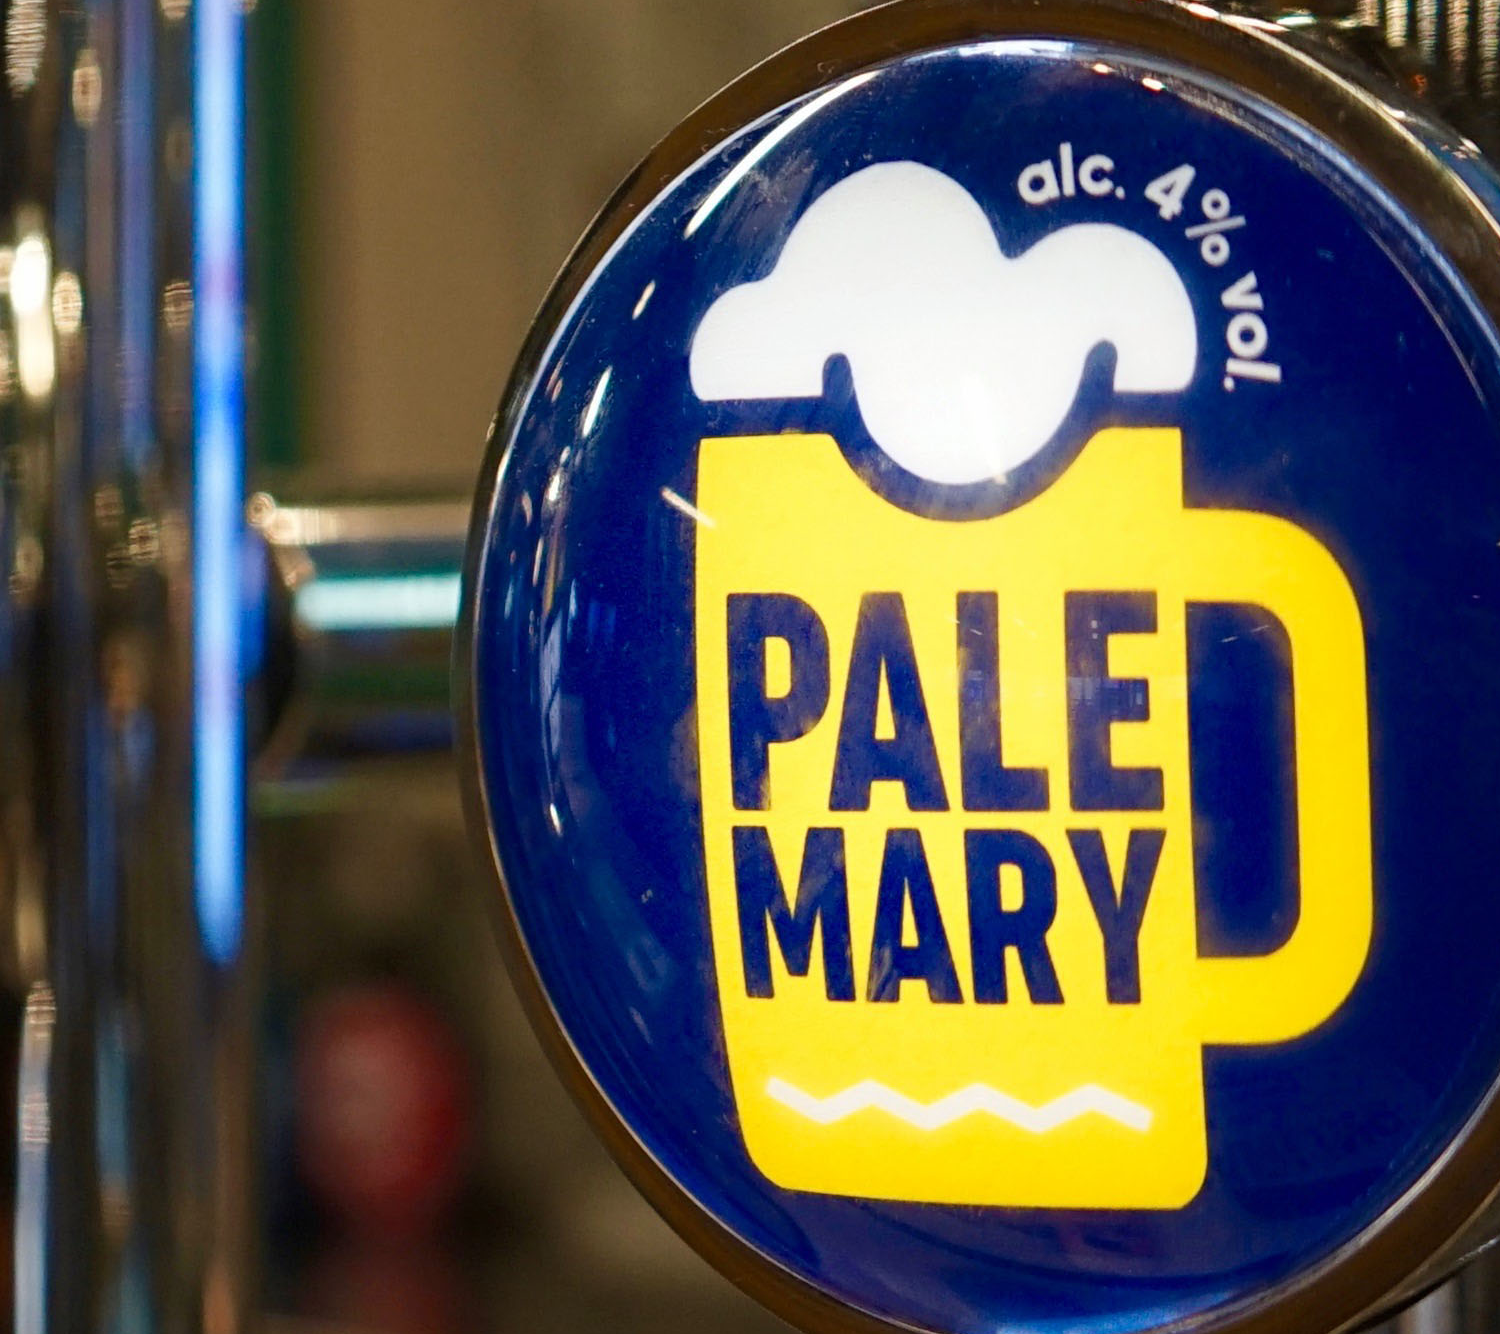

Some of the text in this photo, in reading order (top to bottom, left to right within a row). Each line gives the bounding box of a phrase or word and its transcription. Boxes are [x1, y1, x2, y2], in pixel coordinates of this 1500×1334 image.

[1016, 141, 1126, 206] alc.
[1220, 270, 1282, 392] vol.
[726, 592, 1166, 813] PALE
[731, 825, 1166, 1007] MARY
